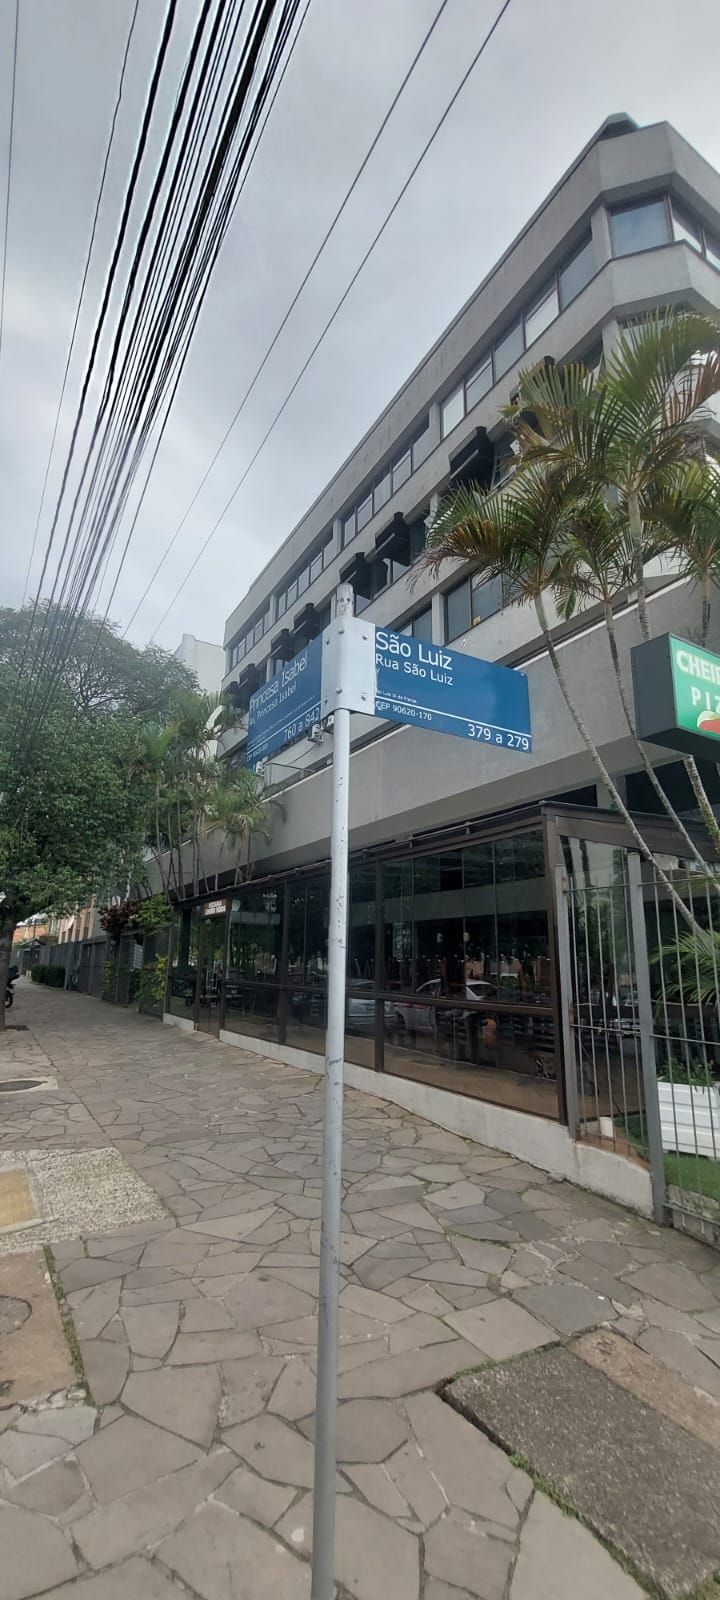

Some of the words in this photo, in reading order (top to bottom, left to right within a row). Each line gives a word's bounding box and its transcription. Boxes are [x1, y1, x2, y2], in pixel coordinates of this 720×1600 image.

[376, 632, 411, 657] São
[419, 644, 452, 670] Luiz
[249, 680, 279, 711] Princesa
[281, 651, 308, 688] Isabel
[375, 653, 399, 670] Rua
[404, 662, 426, 678] São
[431, 671, 453, 685] Luiz
[279, 680, 297, 704] Isabel
[283, 724, 297, 742] 760
[298, 722, 303, 732] a
[305, 708, 320, 728] 842
[376, 700, 391, 710] CEP
[393, 705, 432, 721] 90620-170
[467, 724, 491, 740] 379
[496, 736, 503, 744] a
[508, 735, 529, 750] 279
